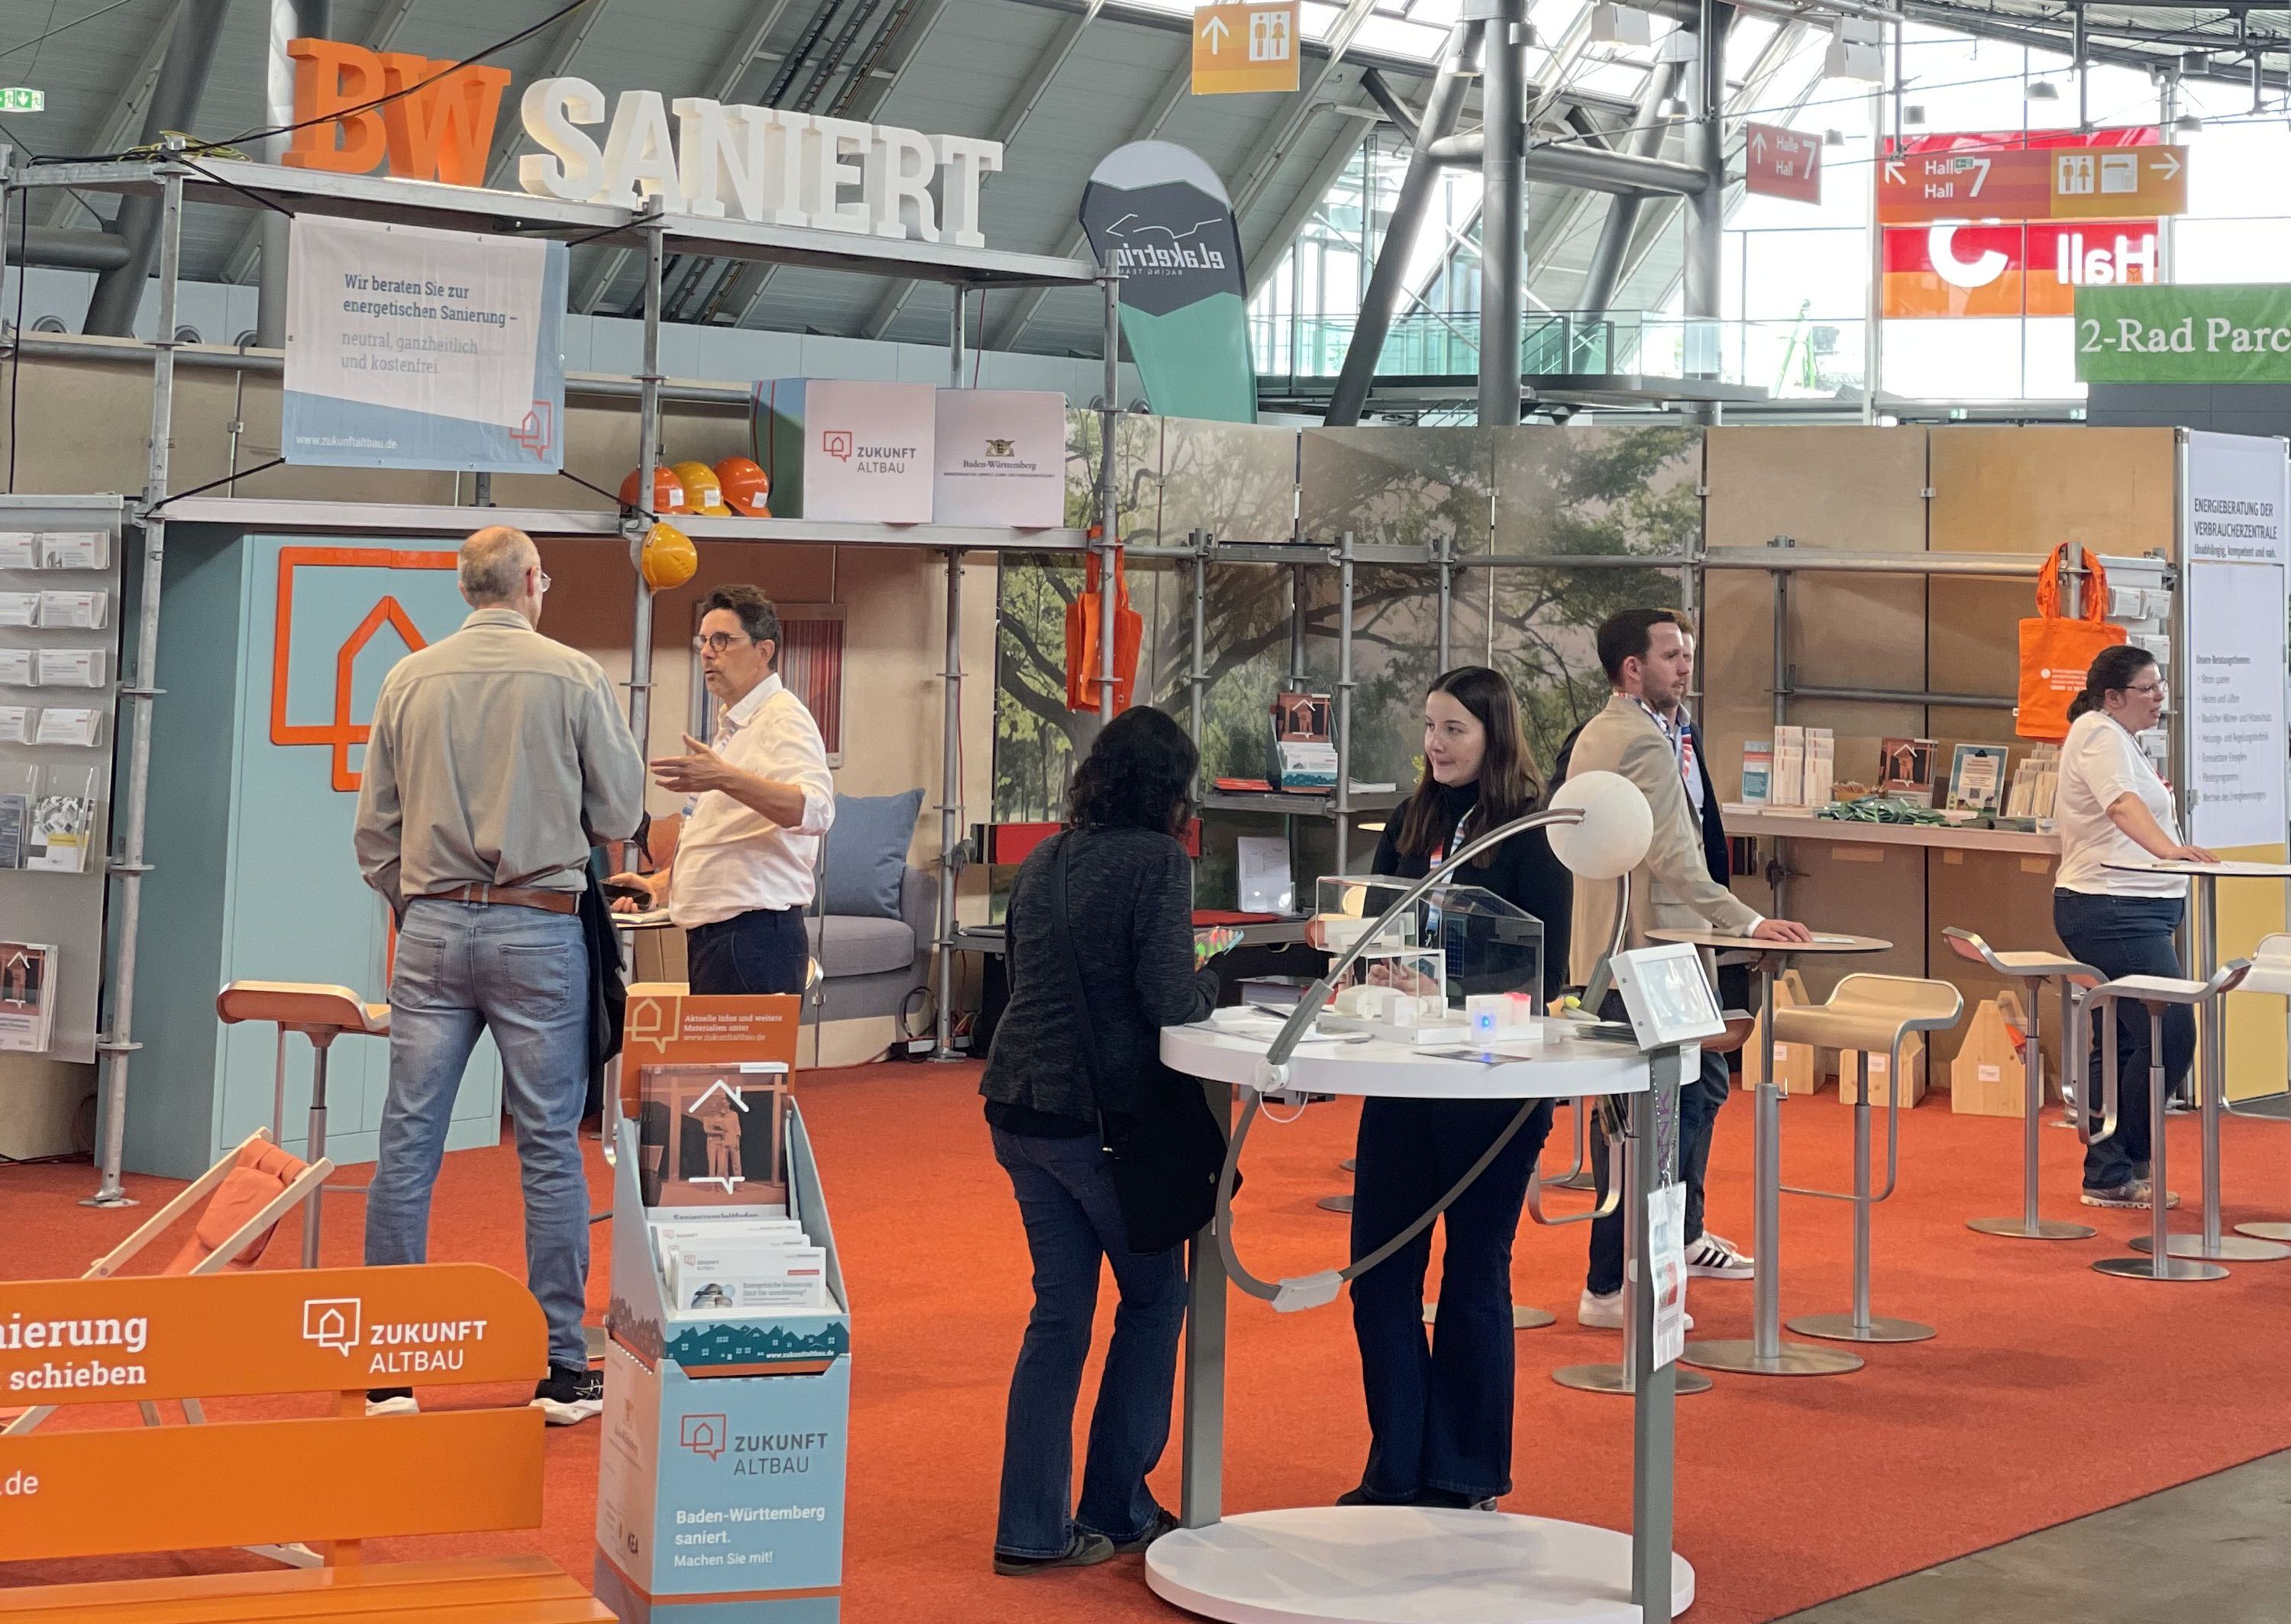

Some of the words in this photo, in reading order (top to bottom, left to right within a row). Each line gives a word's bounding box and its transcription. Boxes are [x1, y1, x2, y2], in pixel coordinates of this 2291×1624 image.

[281, 37, 512, 187] BW
[519, 76, 1003, 248] SANIERT
[1776, 134, 1799, 153] Halle
[1776, 159, 1793, 176] Hall
[1802, 140, 1817, 179] 7
[1969, 158, 1991, 197] 7
[1925, 182, 1953, 199] Hall
[344, 273, 368, 290] Wir
[372, 276, 421, 295] beraten
[425, 281, 444, 297] Sie
[448, 286, 470, 299] zur
[344, 299, 437, 319] energetischen
[441, 305, 506, 328] Sanierung
[342, 331, 393, 350] neutral,
[396, 334, 478, 354] ganzheitlich
[2080, 316, 2196, 353] 2-Rad
[2206, 317, 2291, 353] Parc
[341, 354, 367, 370] und
[371, 354, 441, 375] kostenfrei.
[857, 447, 917, 459] ZUKUNFT
[857, 462, 905, 474] ALTBAU
[963, 460, 1037, 471] Baden-Württemberg
[2194, 498, 2259, 516] ENERGIEBERATUNG
[2260, 502, 2273, 517] DER
[2194, 521, 2277, 540] VERBRAUCHERZENTRALE
[0, 1312, 147, 1353] ierung
[370, 1320, 487, 1345] ZUKUNFT
[369, 1349, 464, 1374] ALTBAU
[10, 1360, 147, 1391] schieben
[734, 1433, 828, 1452] ZUKUNFT
[733, 1456, 809, 1476] ALTBAU
[676, 1505, 826, 1525] Baden-Württemberg
[674, 1530, 732, 1545] saniert.
[674, 1554, 724, 1567] Machen
[727, 1552, 746, 1564] Sie
[749, 1551, 773, 1563] mit!
